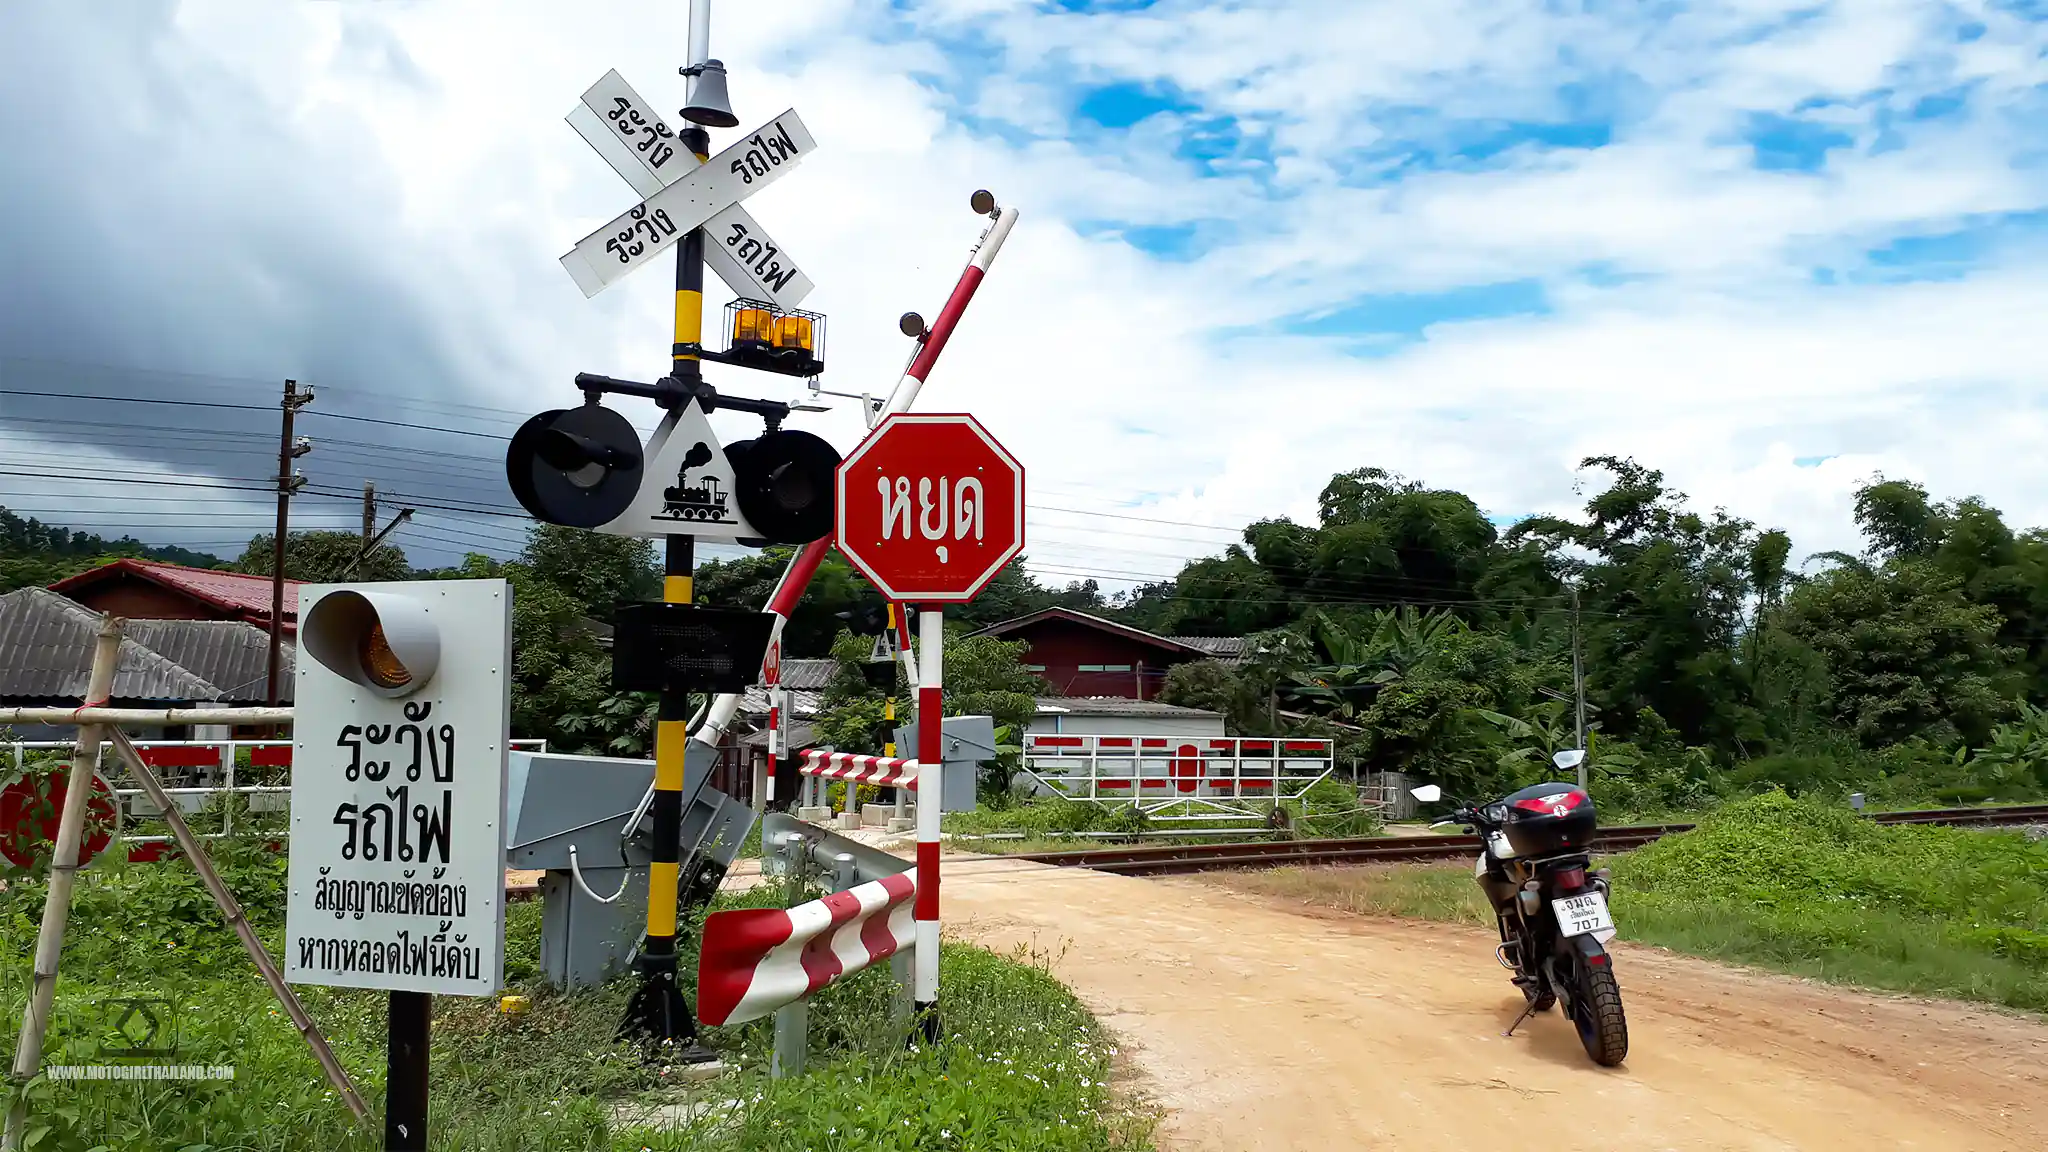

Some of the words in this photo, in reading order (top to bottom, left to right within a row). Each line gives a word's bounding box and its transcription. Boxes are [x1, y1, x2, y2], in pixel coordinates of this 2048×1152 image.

[606, 204, 677, 263] ระวัง
[731, 122, 799, 184] รถไฟ
[607, 97, 673, 169] ระวัง
[727, 224, 797, 294] รถไฟ
[878, 476, 984, 564] หยุด
[337, 702, 455, 782] ระวัง
[333, 786, 452, 863] รถไฟ
[315, 867, 467, 920] สัญญาณขัดข้อง
[1572, 917, 1599, 932] 707
[299, 920, 480, 980] หากหลอดไฟนี้ดับ
